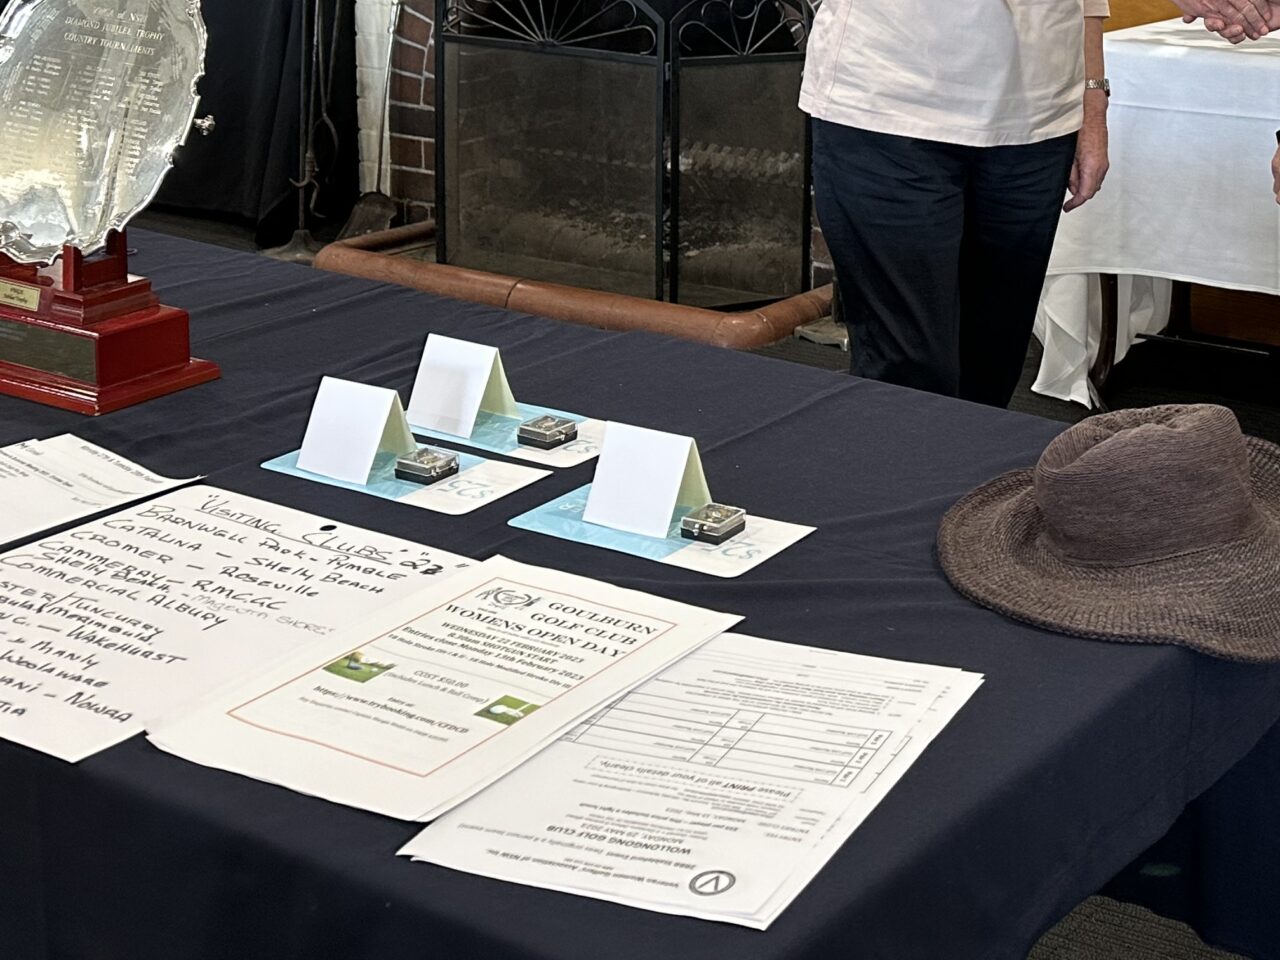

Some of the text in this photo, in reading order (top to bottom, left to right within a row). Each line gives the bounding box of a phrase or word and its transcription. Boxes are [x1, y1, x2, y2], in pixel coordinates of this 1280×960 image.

[446, 604, 525, 631] WOMENS
[527, 628, 580, 645] OPEN
[580, 641, 625, 657] DAY
[530, 613, 637, 645] GOLF CLUB
[548, 602, 656, 634] GOULBURN
